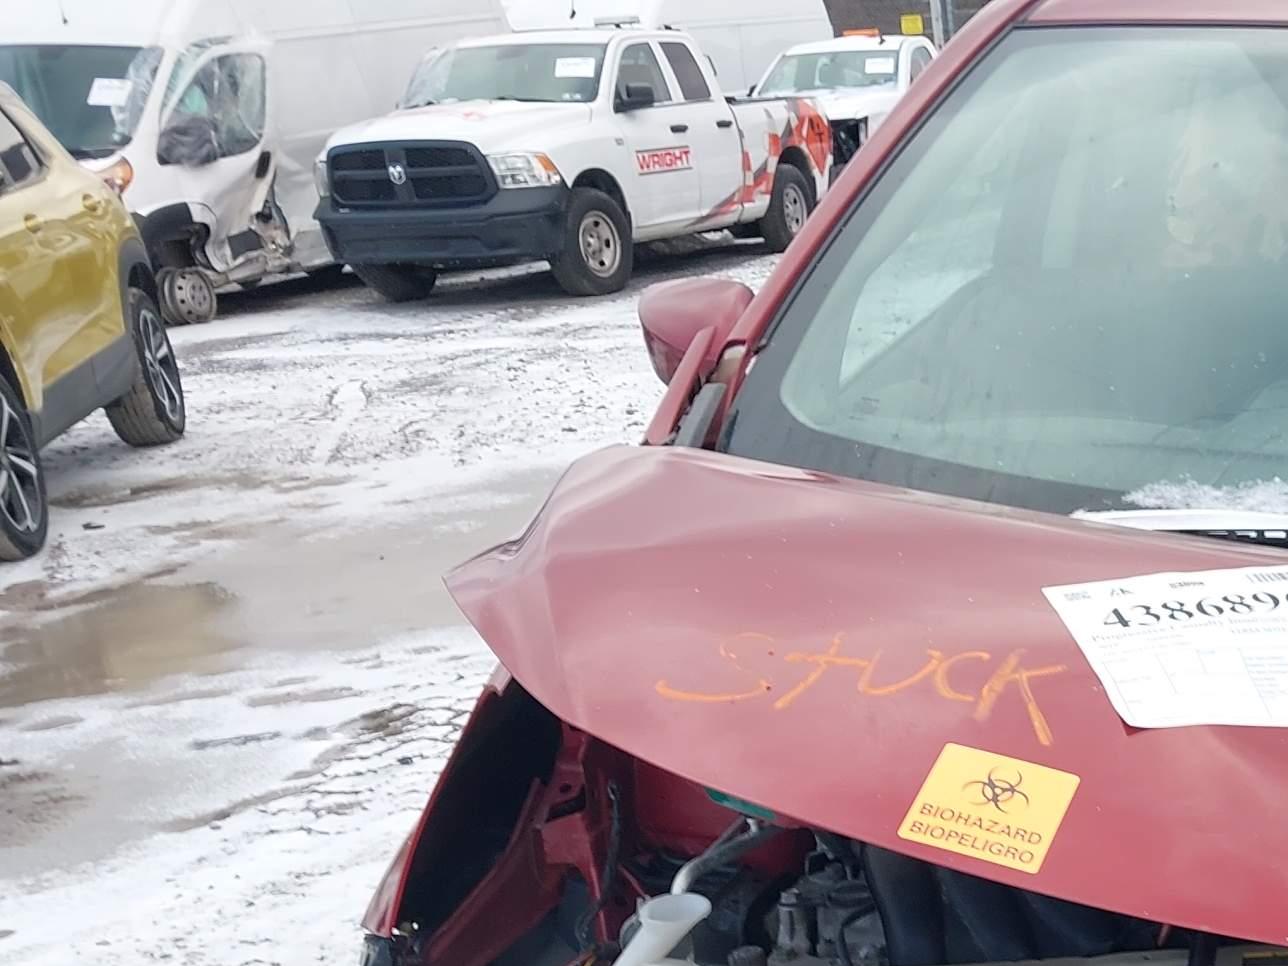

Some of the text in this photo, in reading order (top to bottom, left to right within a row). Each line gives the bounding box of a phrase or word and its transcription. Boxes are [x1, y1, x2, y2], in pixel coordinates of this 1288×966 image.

[636, 150, 690, 171] WRIGHT
[909, 820, 1035, 864] BIOPELIGRO
[919, 802, 1043, 846] BIOHAZARD
